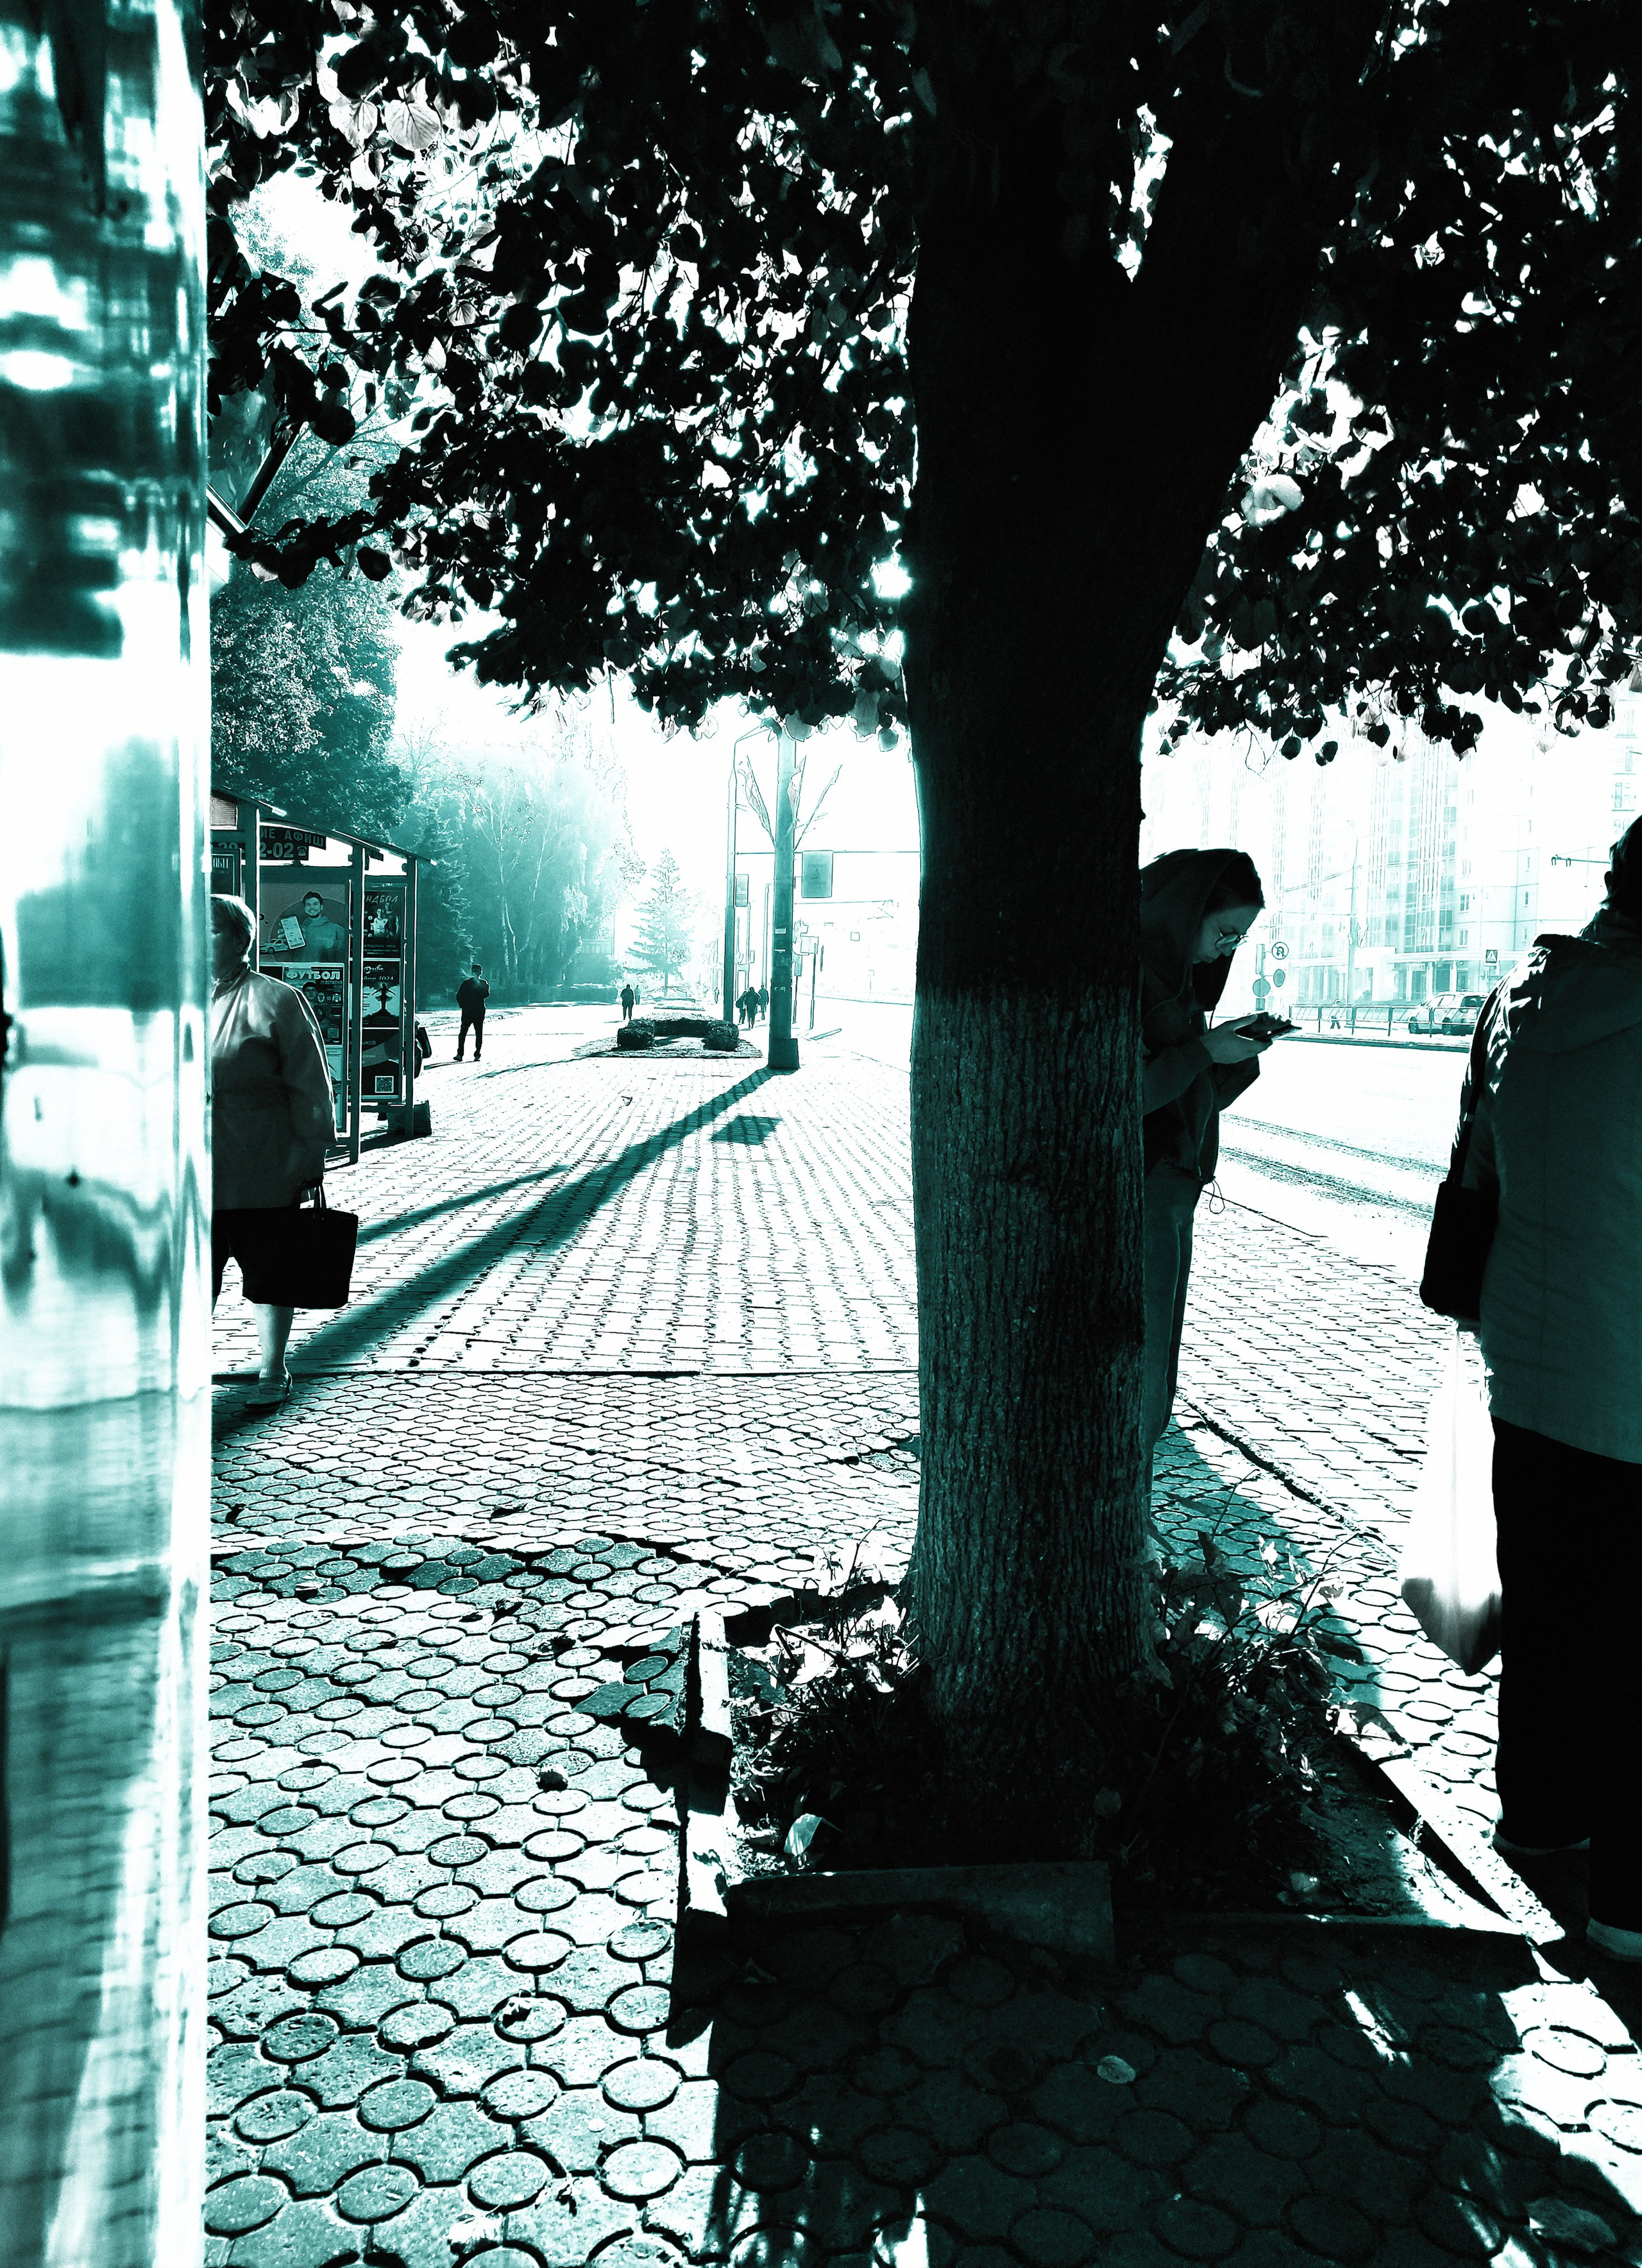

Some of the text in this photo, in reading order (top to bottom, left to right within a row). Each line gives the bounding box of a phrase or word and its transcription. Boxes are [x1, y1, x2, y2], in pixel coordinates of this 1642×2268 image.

[284, 830, 323, 847] АФИШ
[260, 842, 294, 858] 2-02
[366, 895, 398, 904] НДБОЛ
[286, 971, 340, 980] ФУТБОЛ
